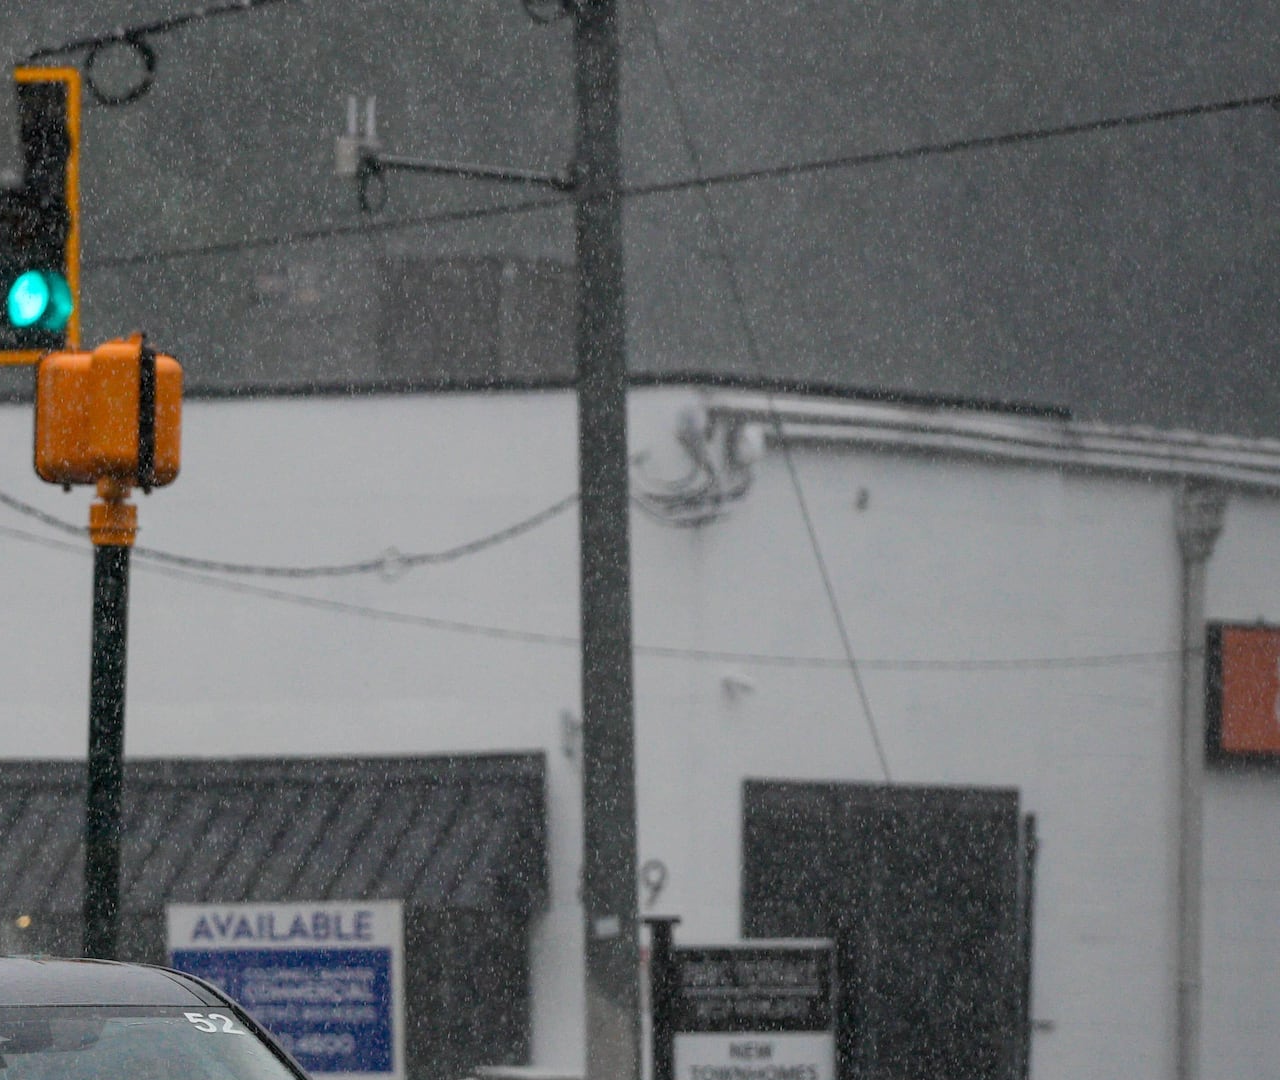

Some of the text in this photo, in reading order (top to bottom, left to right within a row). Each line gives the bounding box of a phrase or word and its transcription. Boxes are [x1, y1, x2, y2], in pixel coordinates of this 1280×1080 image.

[191, 911, 375, 941] AVAILABLE
[184, 1012, 245, 1035] 52
[729, 1042, 772, 1059] NEW
